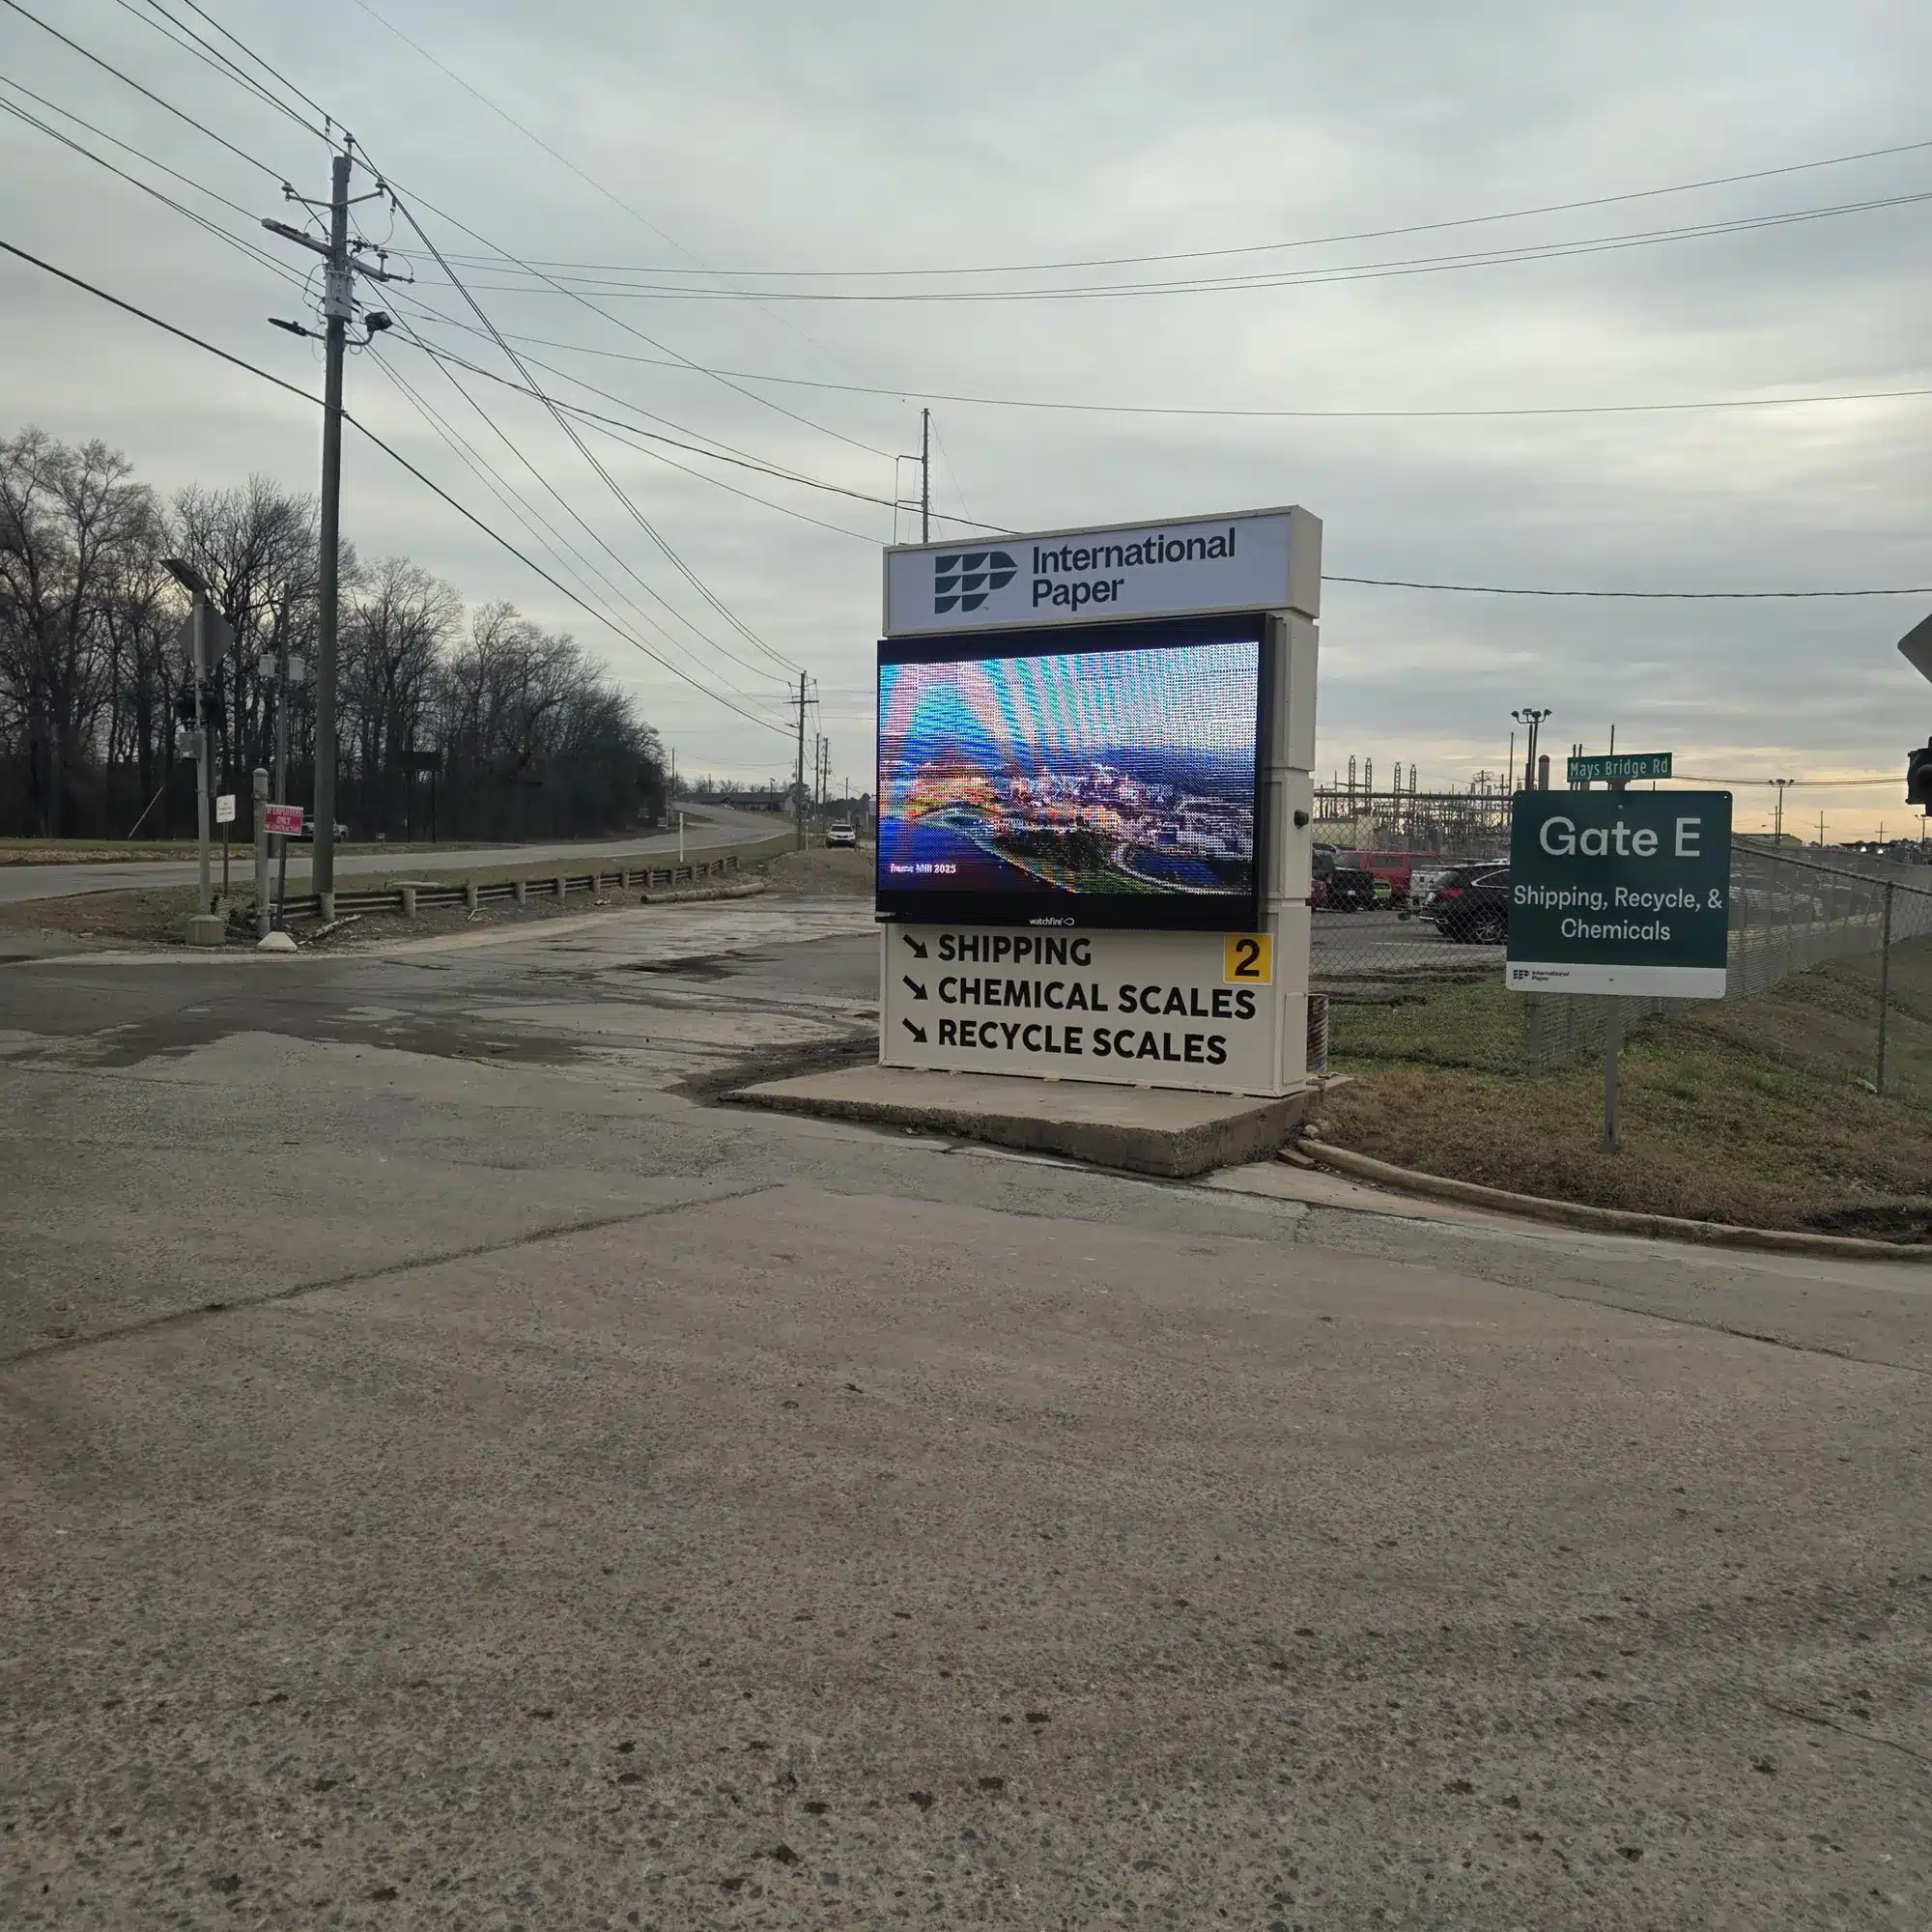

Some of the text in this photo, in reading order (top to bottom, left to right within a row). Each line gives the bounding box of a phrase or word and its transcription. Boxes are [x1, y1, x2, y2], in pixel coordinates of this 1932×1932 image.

[1033, 526, 1236, 574] International
[1032, 579, 1124, 611] Paper
[1570, 757, 1668, 780] Mays Bridge Rd
[276, 816, 292, 825] ONLY
[1539, 816, 1701, 857] Gate E
[934, 864, 956, 874] 2025
[1514, 885, 1723, 912] Shipping, Recycle, &
[1029, 917, 1063, 925] watchfire
[1560, 918, 1671, 941] Chemicals
[937, 933, 1092, 966] SHIPPING
[1234, 938, 1261, 977] 2
[937, 976, 1256, 1020] CHEMICAL SCALES
[938, 1018, 1228, 1065] RECYCLE SCALES
